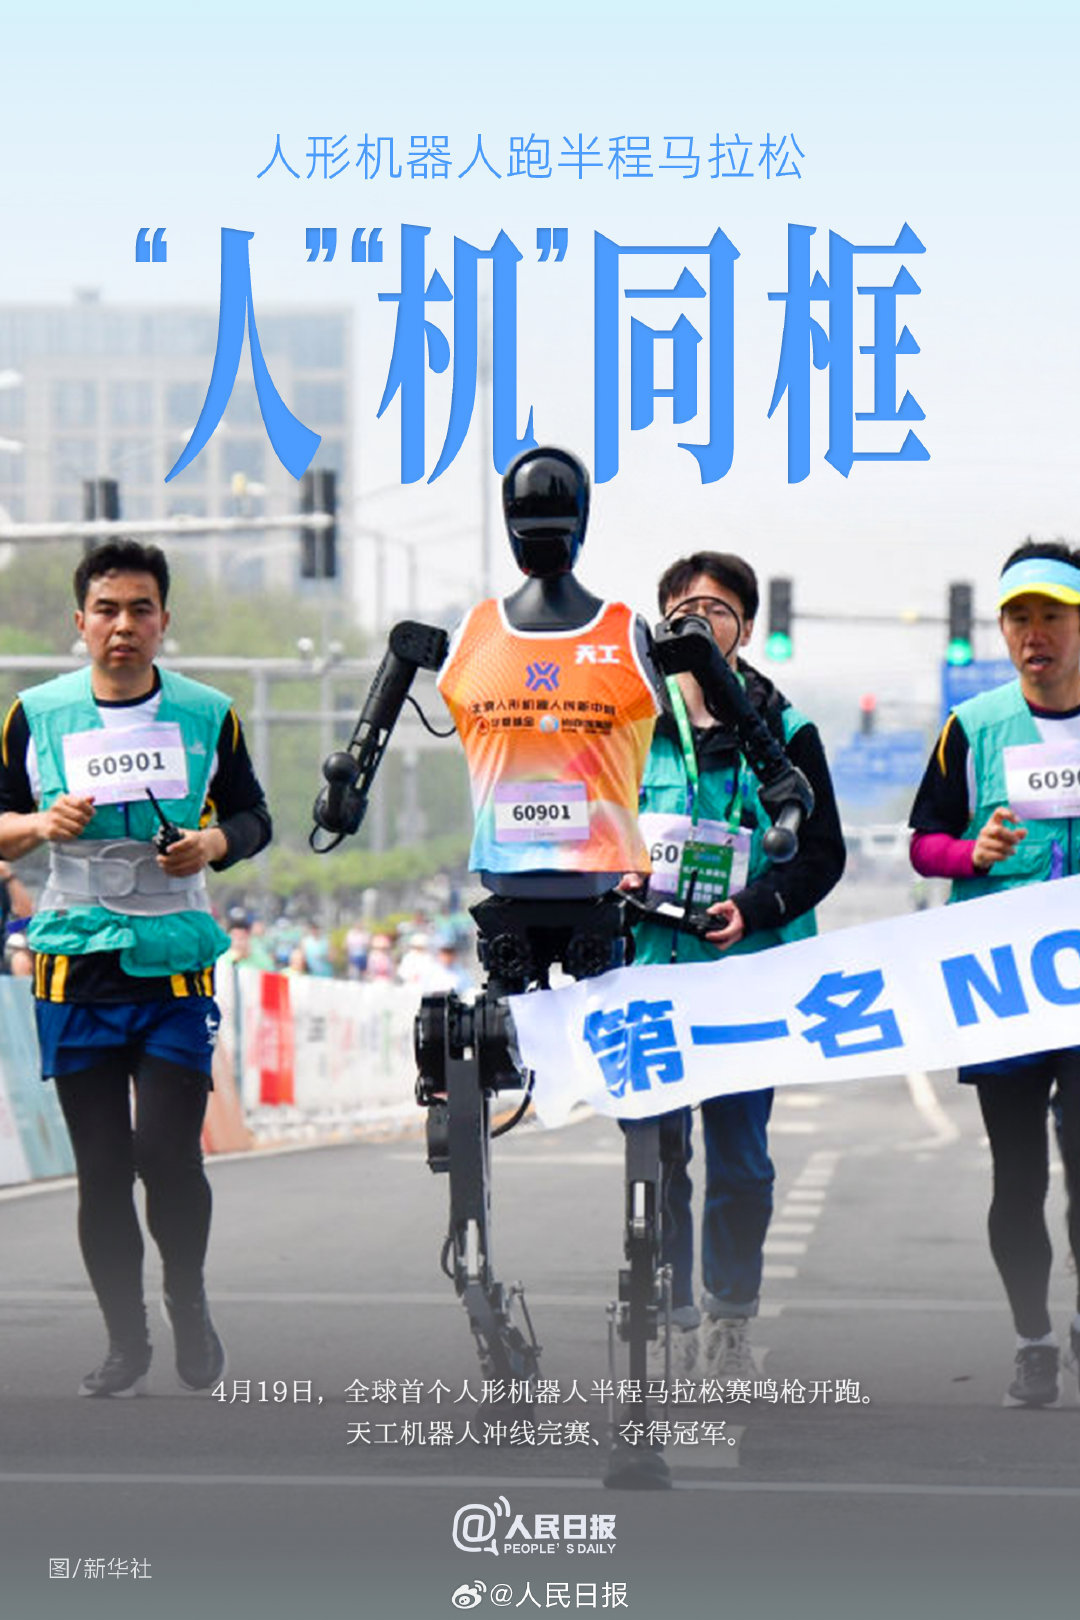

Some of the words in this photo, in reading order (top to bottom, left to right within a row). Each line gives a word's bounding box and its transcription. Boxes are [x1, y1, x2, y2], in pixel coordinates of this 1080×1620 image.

[87, 751, 166, 776] 60901
[1028, 767, 1080, 790] 609
[512, 804, 571, 821] 60901
[583, 969, 904, 1098] 第一名
